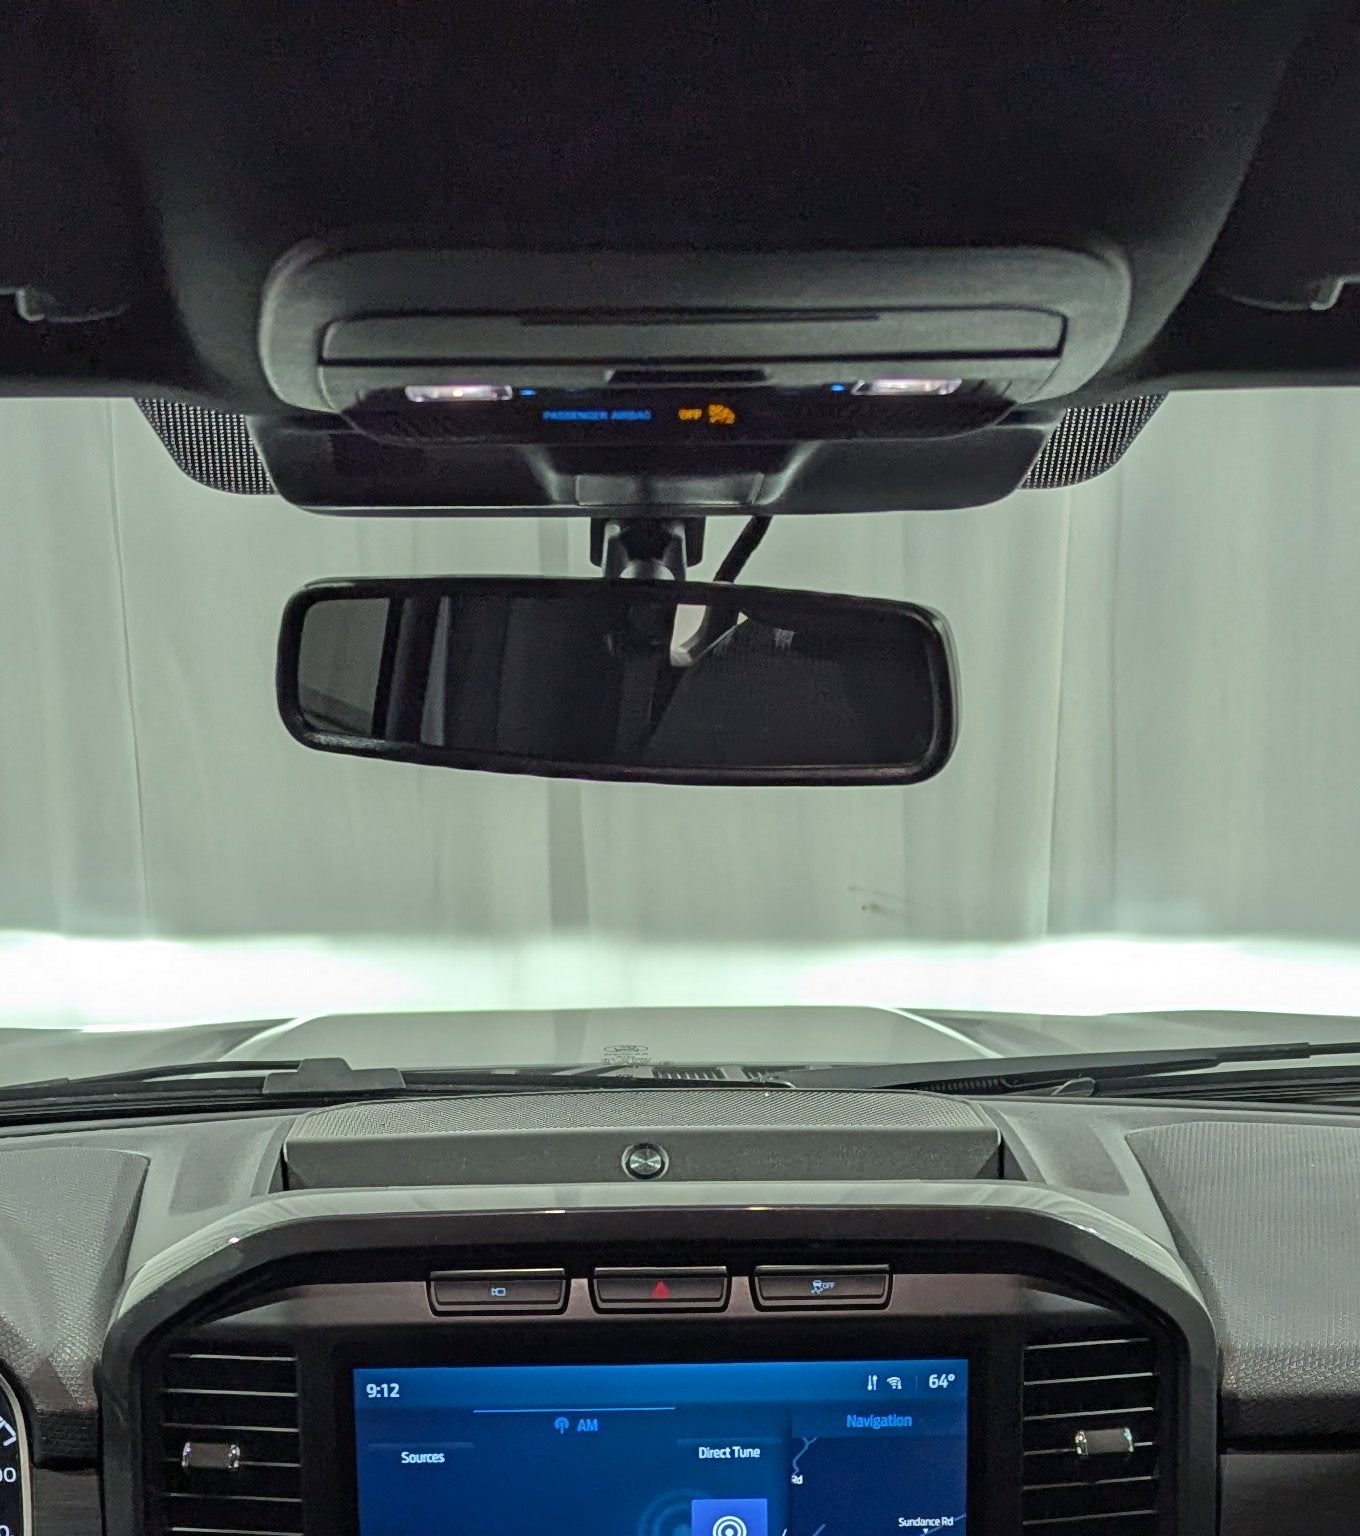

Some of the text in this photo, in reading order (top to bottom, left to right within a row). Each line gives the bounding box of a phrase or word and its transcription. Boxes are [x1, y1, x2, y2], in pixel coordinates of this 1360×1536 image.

[678, 409, 702, 420] OFF
[366, 1383, 400, 1398] 9:12
[577, 1419, 598, 1432] AM
[846, 1414, 913, 1429] Navigation
[401, 1451, 445, 1464] Sources
[698, 1446, 761, 1459] Direct Tune
[898, 1517, 954, 1527] Sundance Rd
